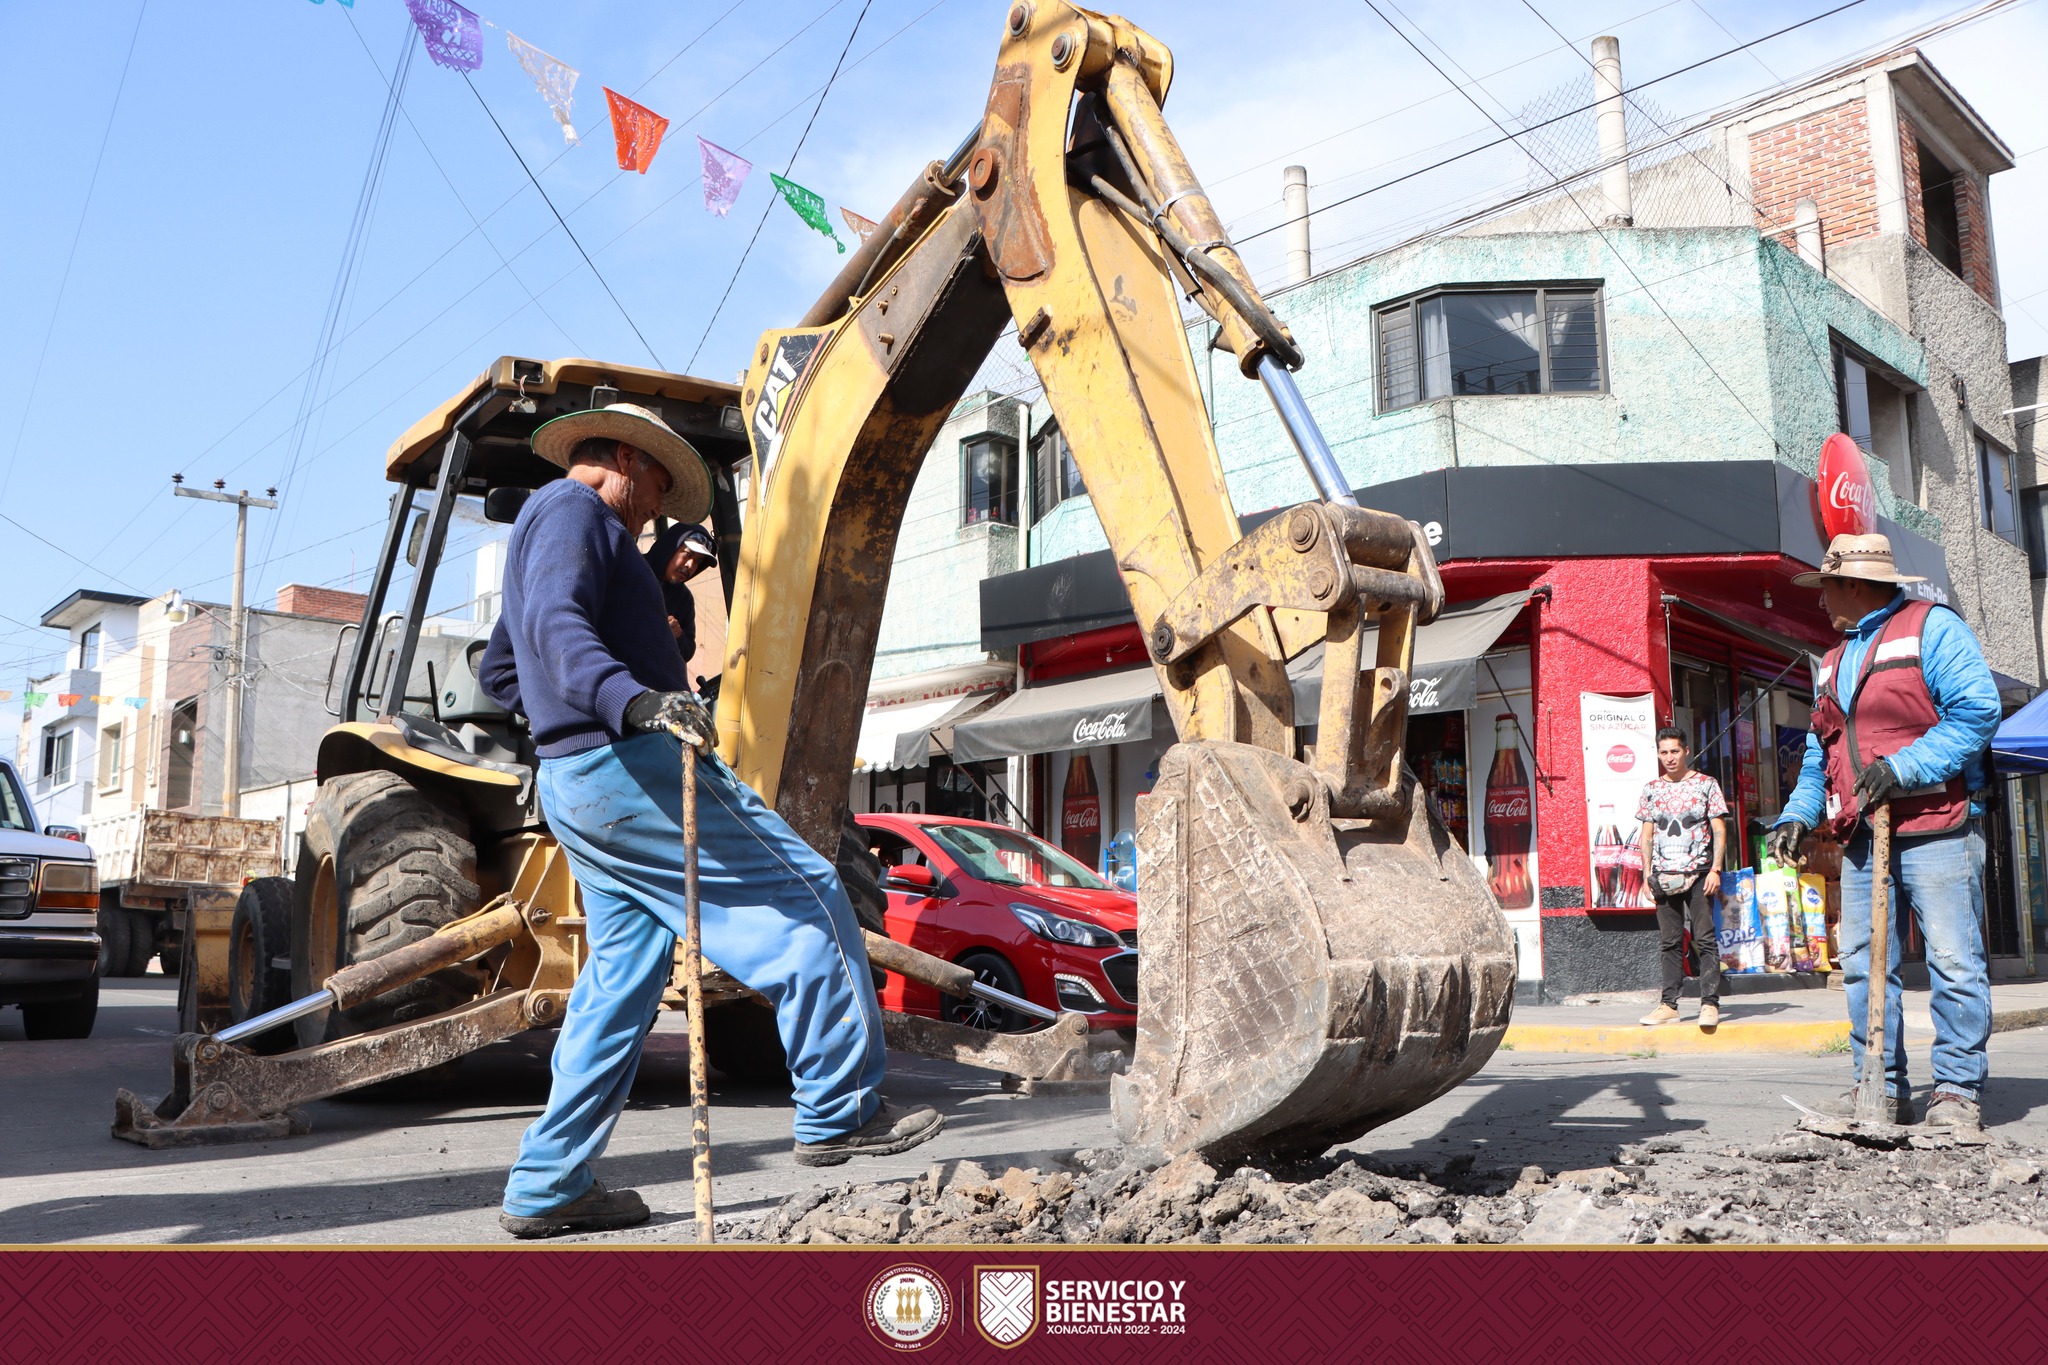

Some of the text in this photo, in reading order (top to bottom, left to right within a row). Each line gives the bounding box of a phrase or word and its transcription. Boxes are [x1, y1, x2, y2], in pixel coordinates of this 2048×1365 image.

[755, 346, 797, 440] CAT
[1589, 714, 1646, 722] ORIGINAL O
[1590, 721, 1647, 731] SIN AZÚCAR
[1487, 797, 1529, 818] Coca-Cola
[1064, 807, 1099, 830] Coca-Cola
